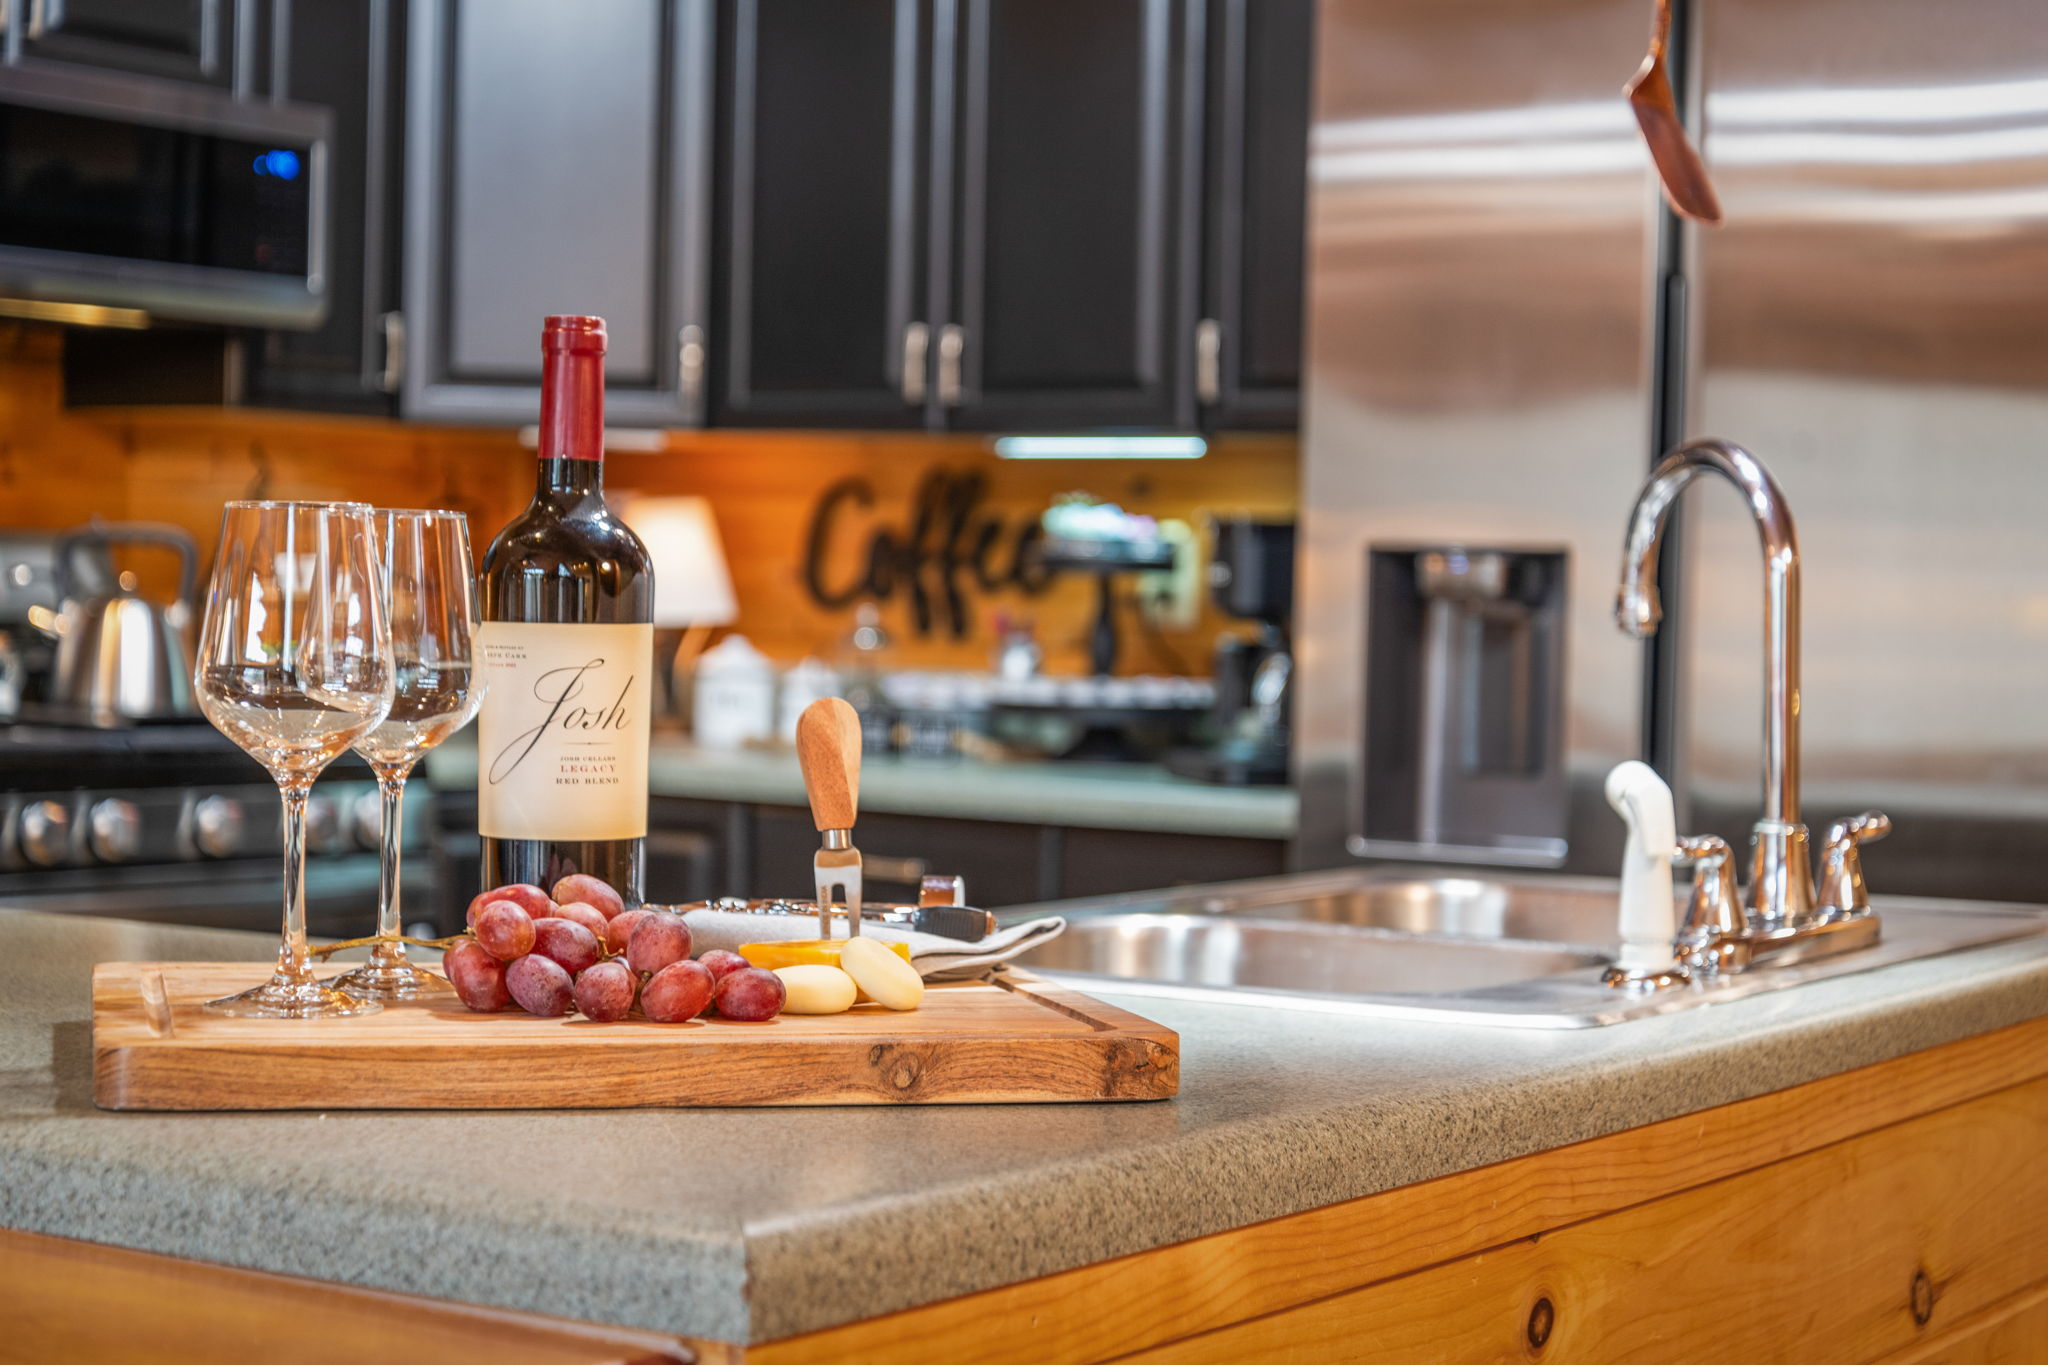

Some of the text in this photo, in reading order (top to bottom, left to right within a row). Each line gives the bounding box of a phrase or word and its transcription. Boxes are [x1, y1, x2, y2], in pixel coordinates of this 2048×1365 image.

[489, 658, 634, 785] Josh
[560, 764, 617, 773] LEGACY
[556, 777, 619, 785] RED BLEND
